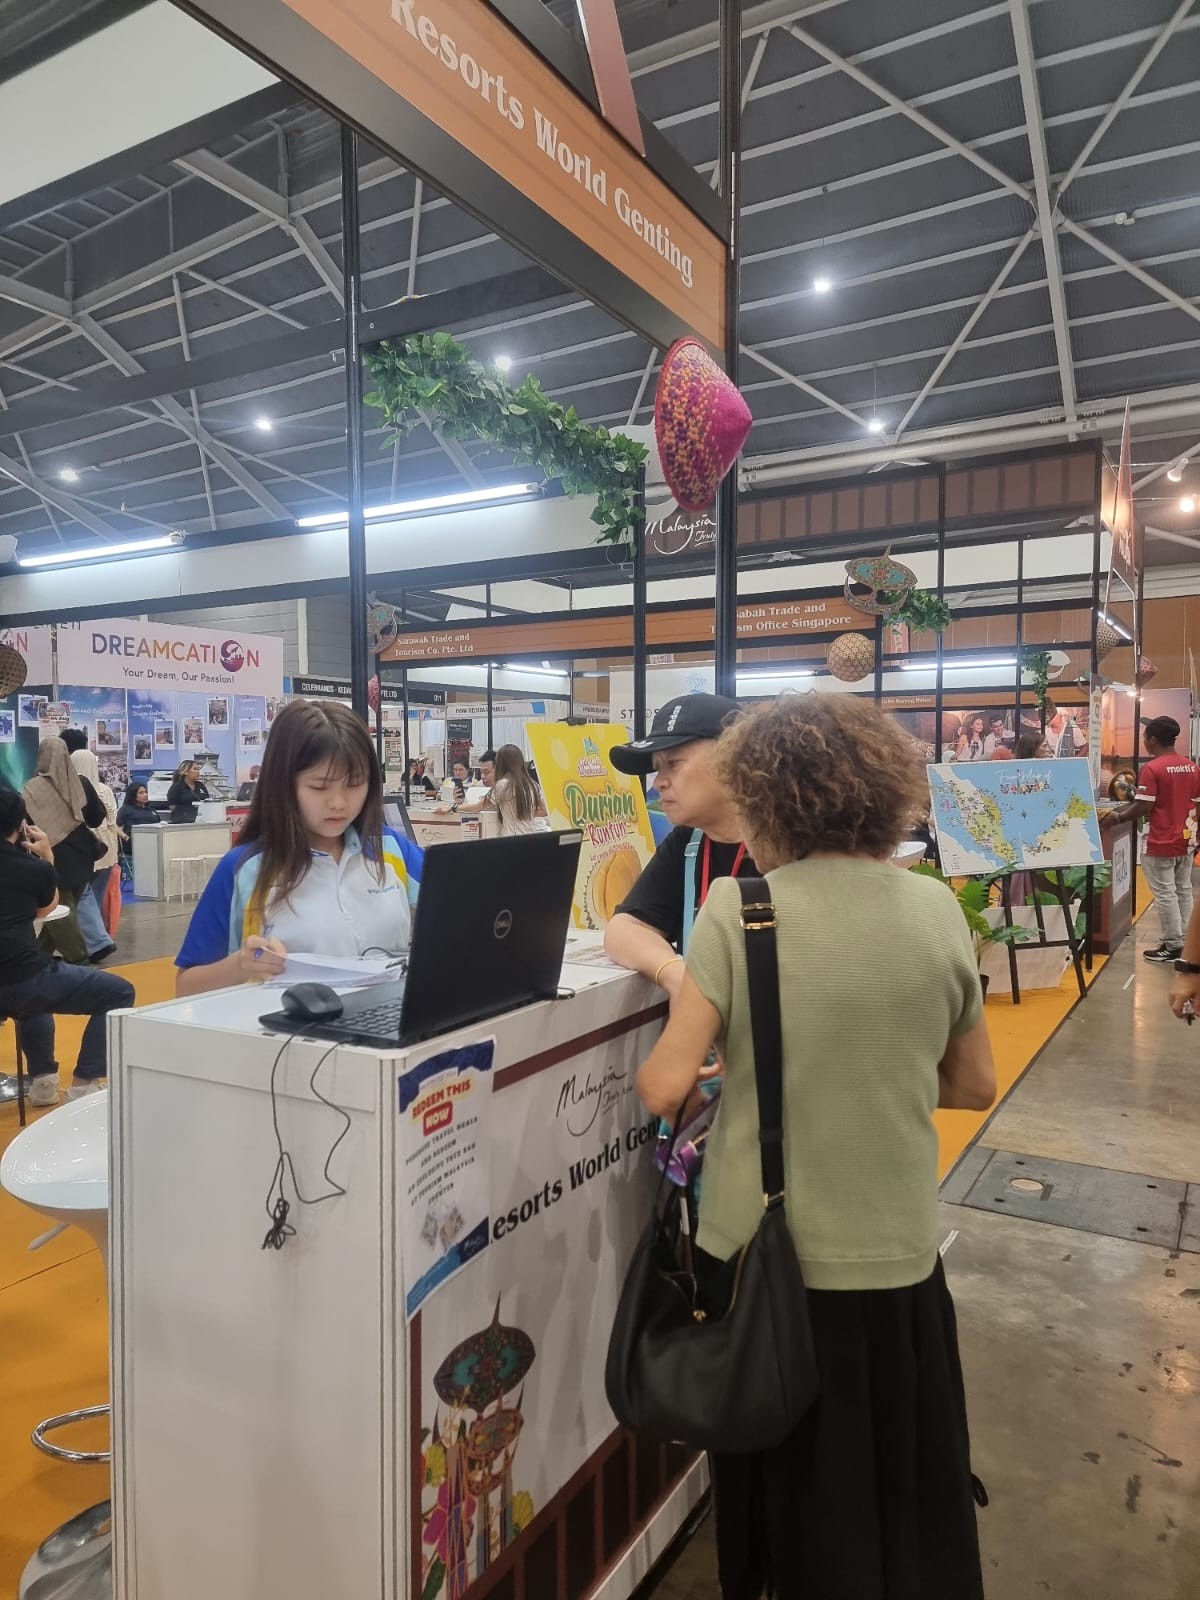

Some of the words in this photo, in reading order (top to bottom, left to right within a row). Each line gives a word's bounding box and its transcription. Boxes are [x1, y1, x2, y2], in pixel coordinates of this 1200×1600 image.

[389, 0, 525, 131] Resorts
[533, 106, 609, 208] World
[614, 187, 694, 289] Genting
[644, 514, 717, 556] Malaysia
[768, 604, 801, 617] Trade
[804, 602, 827, 614] and
[755, 620, 789, 632] Office
[791, 614, 852, 630] Singapore
[394, 647, 425, 657] Tourism
[427, 646, 440, 656] Co.
[459, 644, 474, 654] Ltd
[397, 635, 429, 647] Sarawak
[431, 634, 454, 645] Trade
[455, 632, 471, 643] and
[122, 666, 145, 679] Your
[146, 669, 180, 682] Dream,
[181, 671, 198, 683] Our
[200, 672, 236, 685] Passion!
[566, 781, 637, 827] Durian
[412, 1089, 445, 1120] REDEEM
[446, 1079, 471, 1098] THIS
[555, 1064, 629, 1137] Malaysia
[425, 1107, 450, 1129] NOW
[443, 1155, 475, 1179] MALAYSIA
[491, 1178, 563, 1244] esorts
[569, 1138, 620, 1192] World
